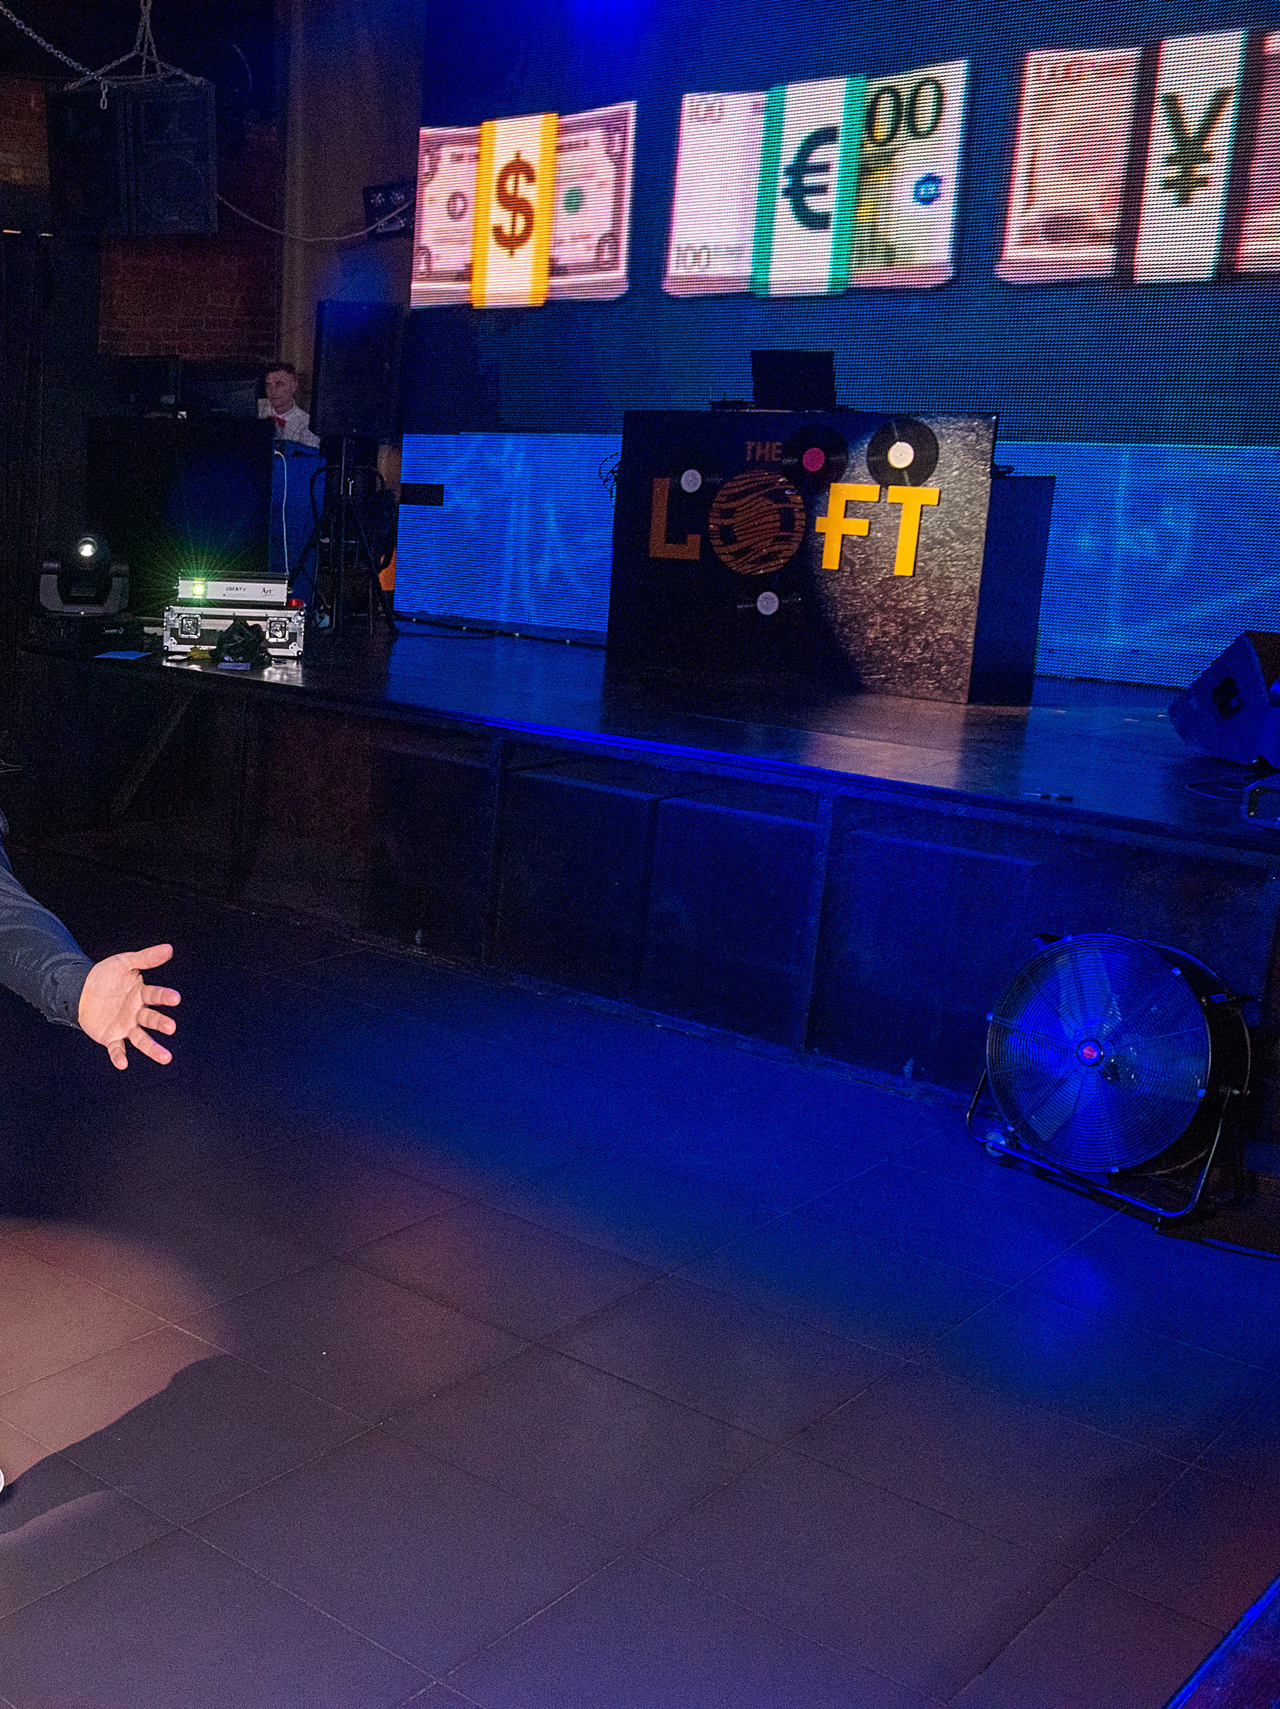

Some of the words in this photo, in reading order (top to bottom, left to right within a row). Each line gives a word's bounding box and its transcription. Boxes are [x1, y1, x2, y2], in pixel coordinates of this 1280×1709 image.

[865, 79, 944, 143] 00
[1161, 86, 1235, 206] ¥
[492, 150, 537, 258] $
[781, 126, 839, 231] €
[745, 441, 783, 462] THE
[649, 470, 940, 577] LOFT
